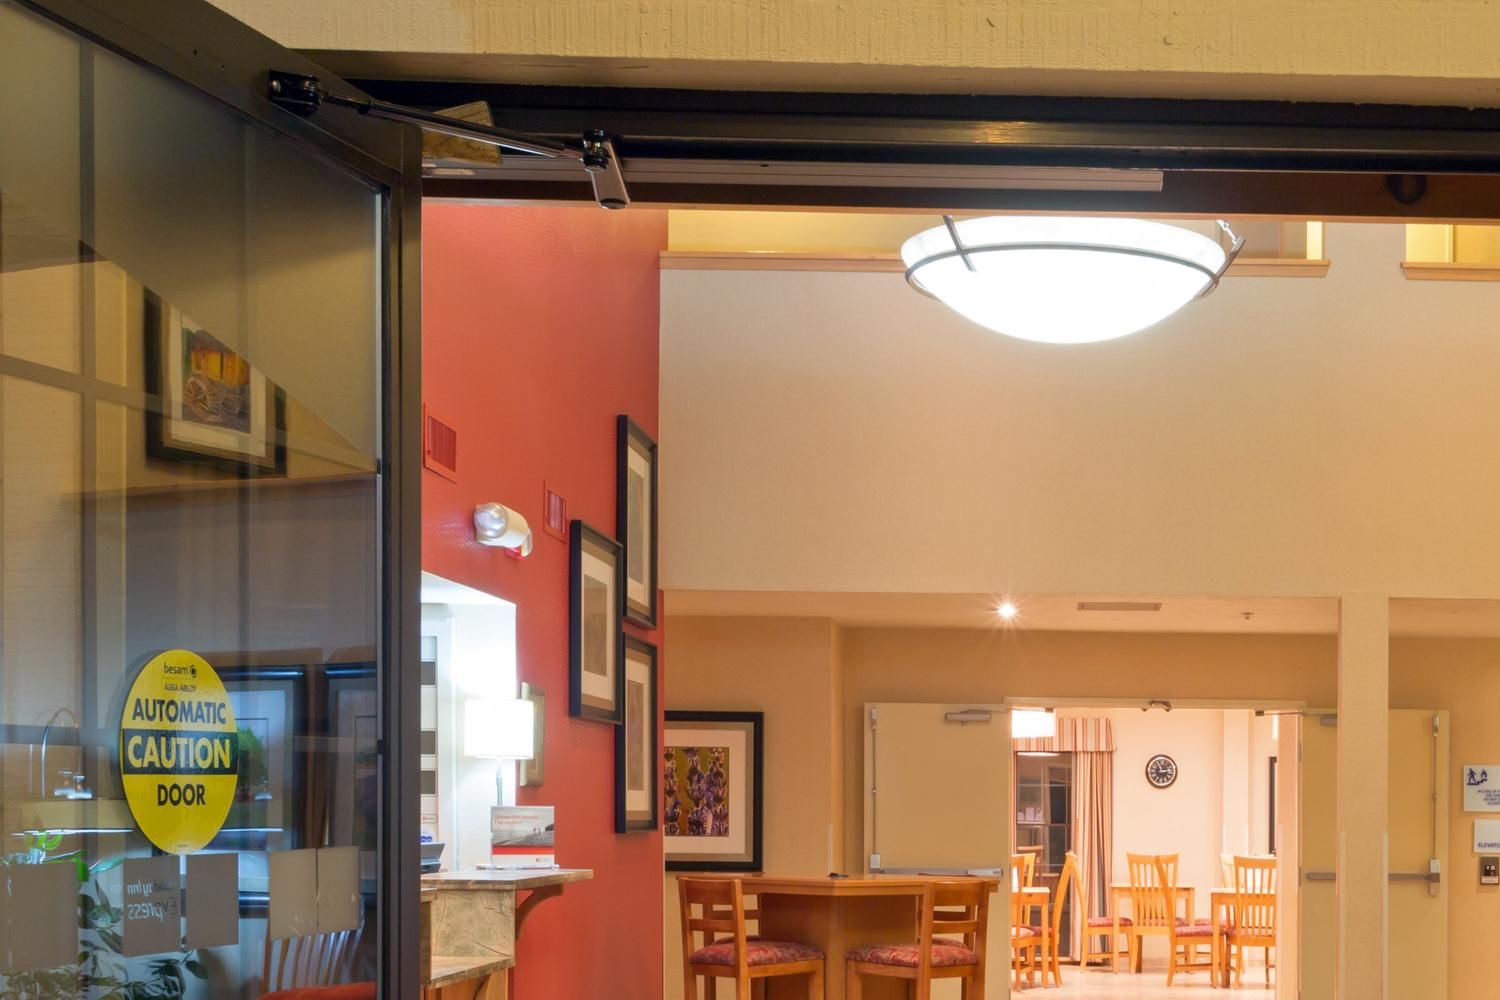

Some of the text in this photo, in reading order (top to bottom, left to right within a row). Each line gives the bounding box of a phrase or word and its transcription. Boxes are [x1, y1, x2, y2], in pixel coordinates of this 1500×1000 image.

[163, 662, 188, 675] besam
[132, 698, 226, 724] AUTOMATIC
[128, 735, 231, 769] CAUTION
[157, 783, 206, 806] DOOR
